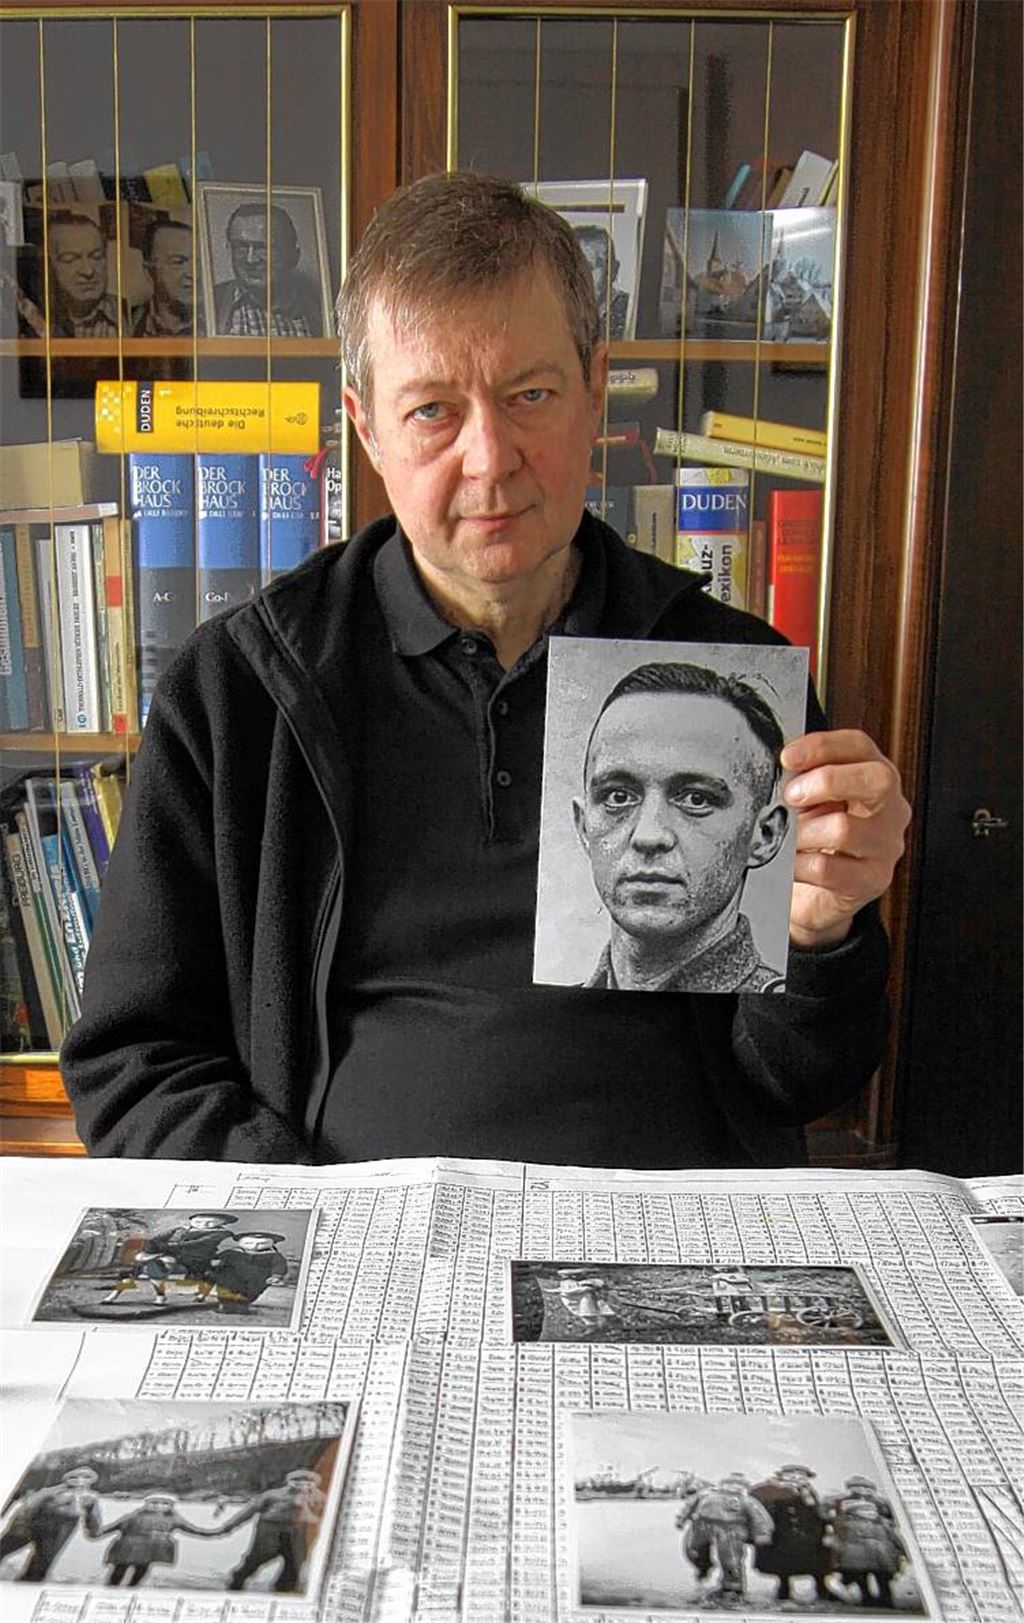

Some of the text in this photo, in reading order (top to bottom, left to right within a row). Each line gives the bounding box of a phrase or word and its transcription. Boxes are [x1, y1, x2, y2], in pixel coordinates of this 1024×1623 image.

[140, 389, 151, 432] DUDEN
[175, 405, 265, 418] Rechtschreibung
[175, 418, 246, 430] Die deutsche
[133, 466, 161, 480] DER
[199, 466, 227, 480] DER
[263, 468, 290, 481] DER
[133, 480, 181, 494] BROCK
[199, 480, 246, 494] BROCK
[133, 494, 172, 508] HAUS
[199, 494, 238, 509] HAUS
[682, 493, 747, 510] DUDEN
[717, 544, 732, 602] exikon
